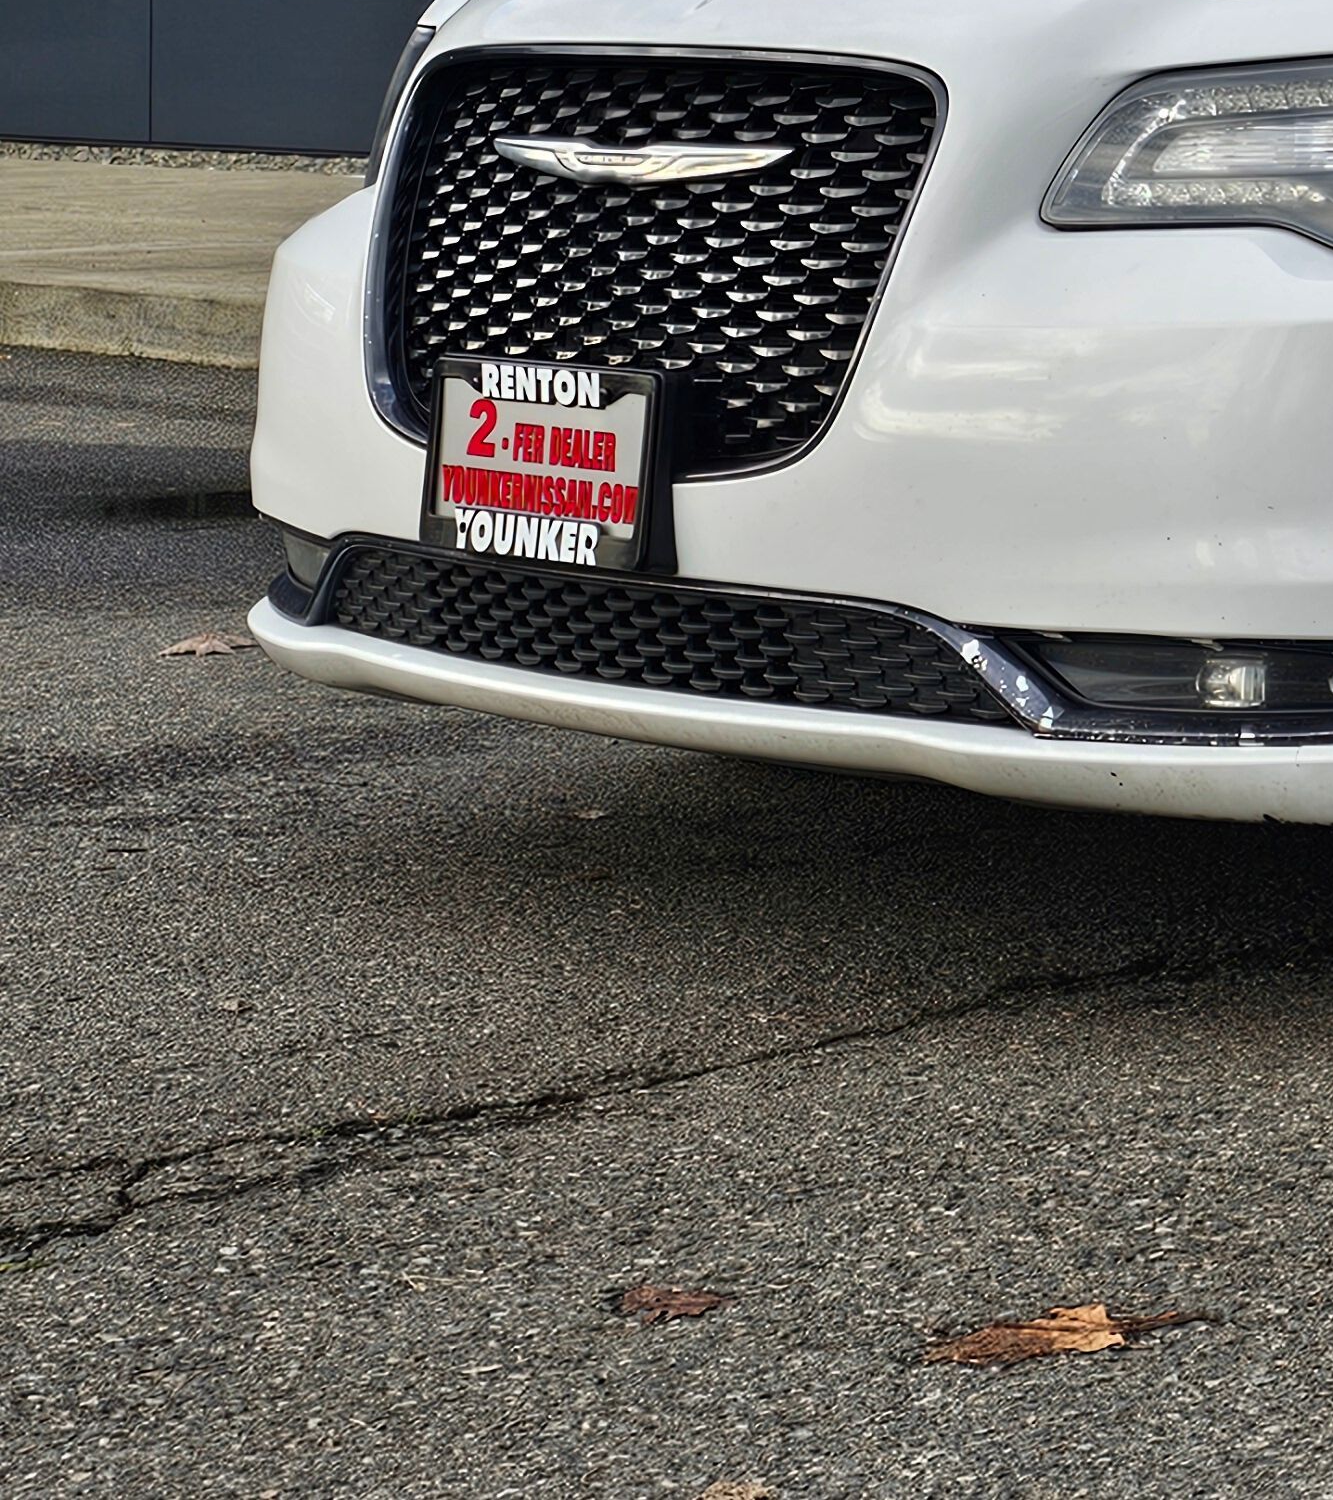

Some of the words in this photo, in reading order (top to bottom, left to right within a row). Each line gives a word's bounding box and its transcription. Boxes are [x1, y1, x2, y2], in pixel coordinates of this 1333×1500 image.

[481, 363, 600, 408] RENTON
[550, 427, 616, 472] DEALER
[454, 509, 599, 566] YOUNKER
